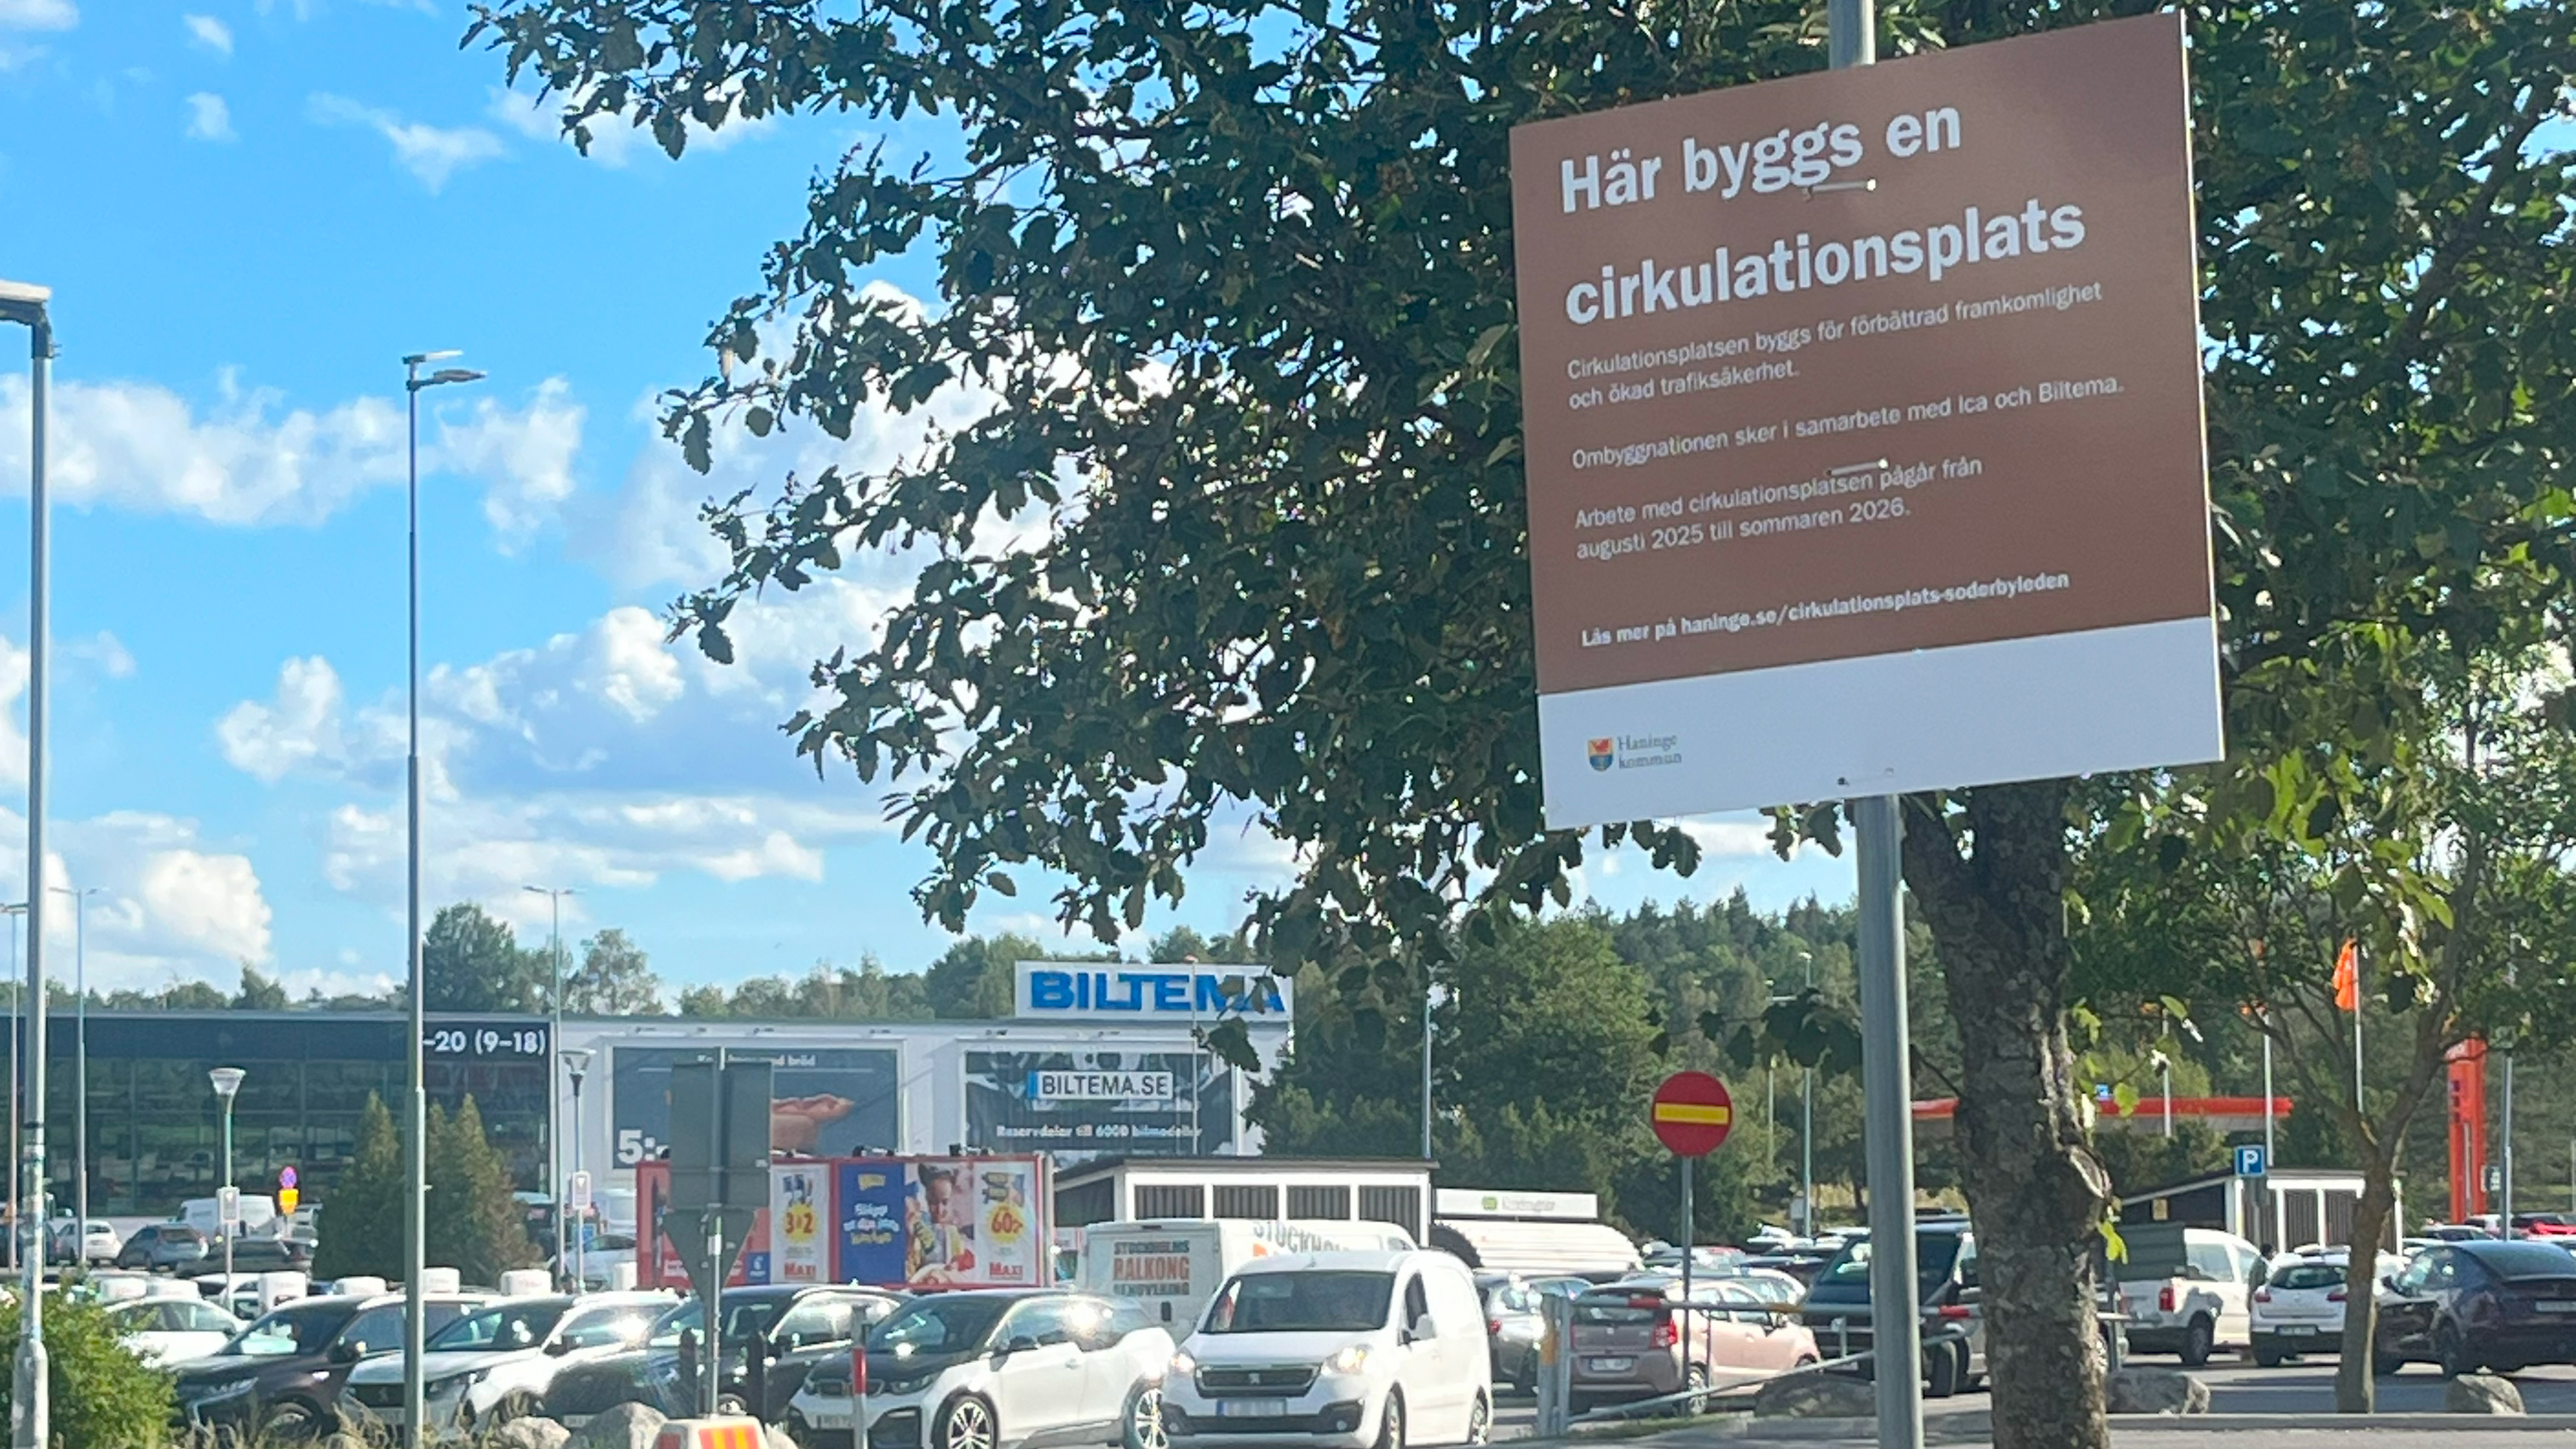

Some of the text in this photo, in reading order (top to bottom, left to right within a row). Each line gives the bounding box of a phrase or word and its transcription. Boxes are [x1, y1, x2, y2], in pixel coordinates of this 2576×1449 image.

[1561, 106, 1961, 213] Här byggs en
[1565, 198, 2086, 325] cirkulationsplats
[1567, 282, 2102, 380] Cirkulationsplatsen byggs för förbättrad framkomlighet
[1569, 359, 1800, 410] och ökad trafiksäkerhet.
[1573, 376, 2125, 469] Ombyggnationen sker i samarbete med Ica och Biltema.
[1575, 457, 1982, 529] Arbete med cirkulationsplatsen pågår från
[1576, 497, 1911, 561] augusti 2025 till sommaren 2026.
[1617, 624, 1650, 642] mer
[1655, 616, 1676, 641] på
[1681, 572, 2071, 635] haninge.se/cirkulationsplats-soderbyleden
[1618, 733, 1677, 752] Haninge
[1619, 753, 1682, 769] kommun
[1031, 971, 1285, 1012] BILTEMA
[423, 1029, 546, 1056] -20 (9-18)
[1042, 1075, 1170, 1095] BILTEMA.SE
[996, 1124, 1072, 1137] Reservdelar
[1095, 1124, 1130, 1137] 6000
[2243, 1149, 2259, 1173] P
